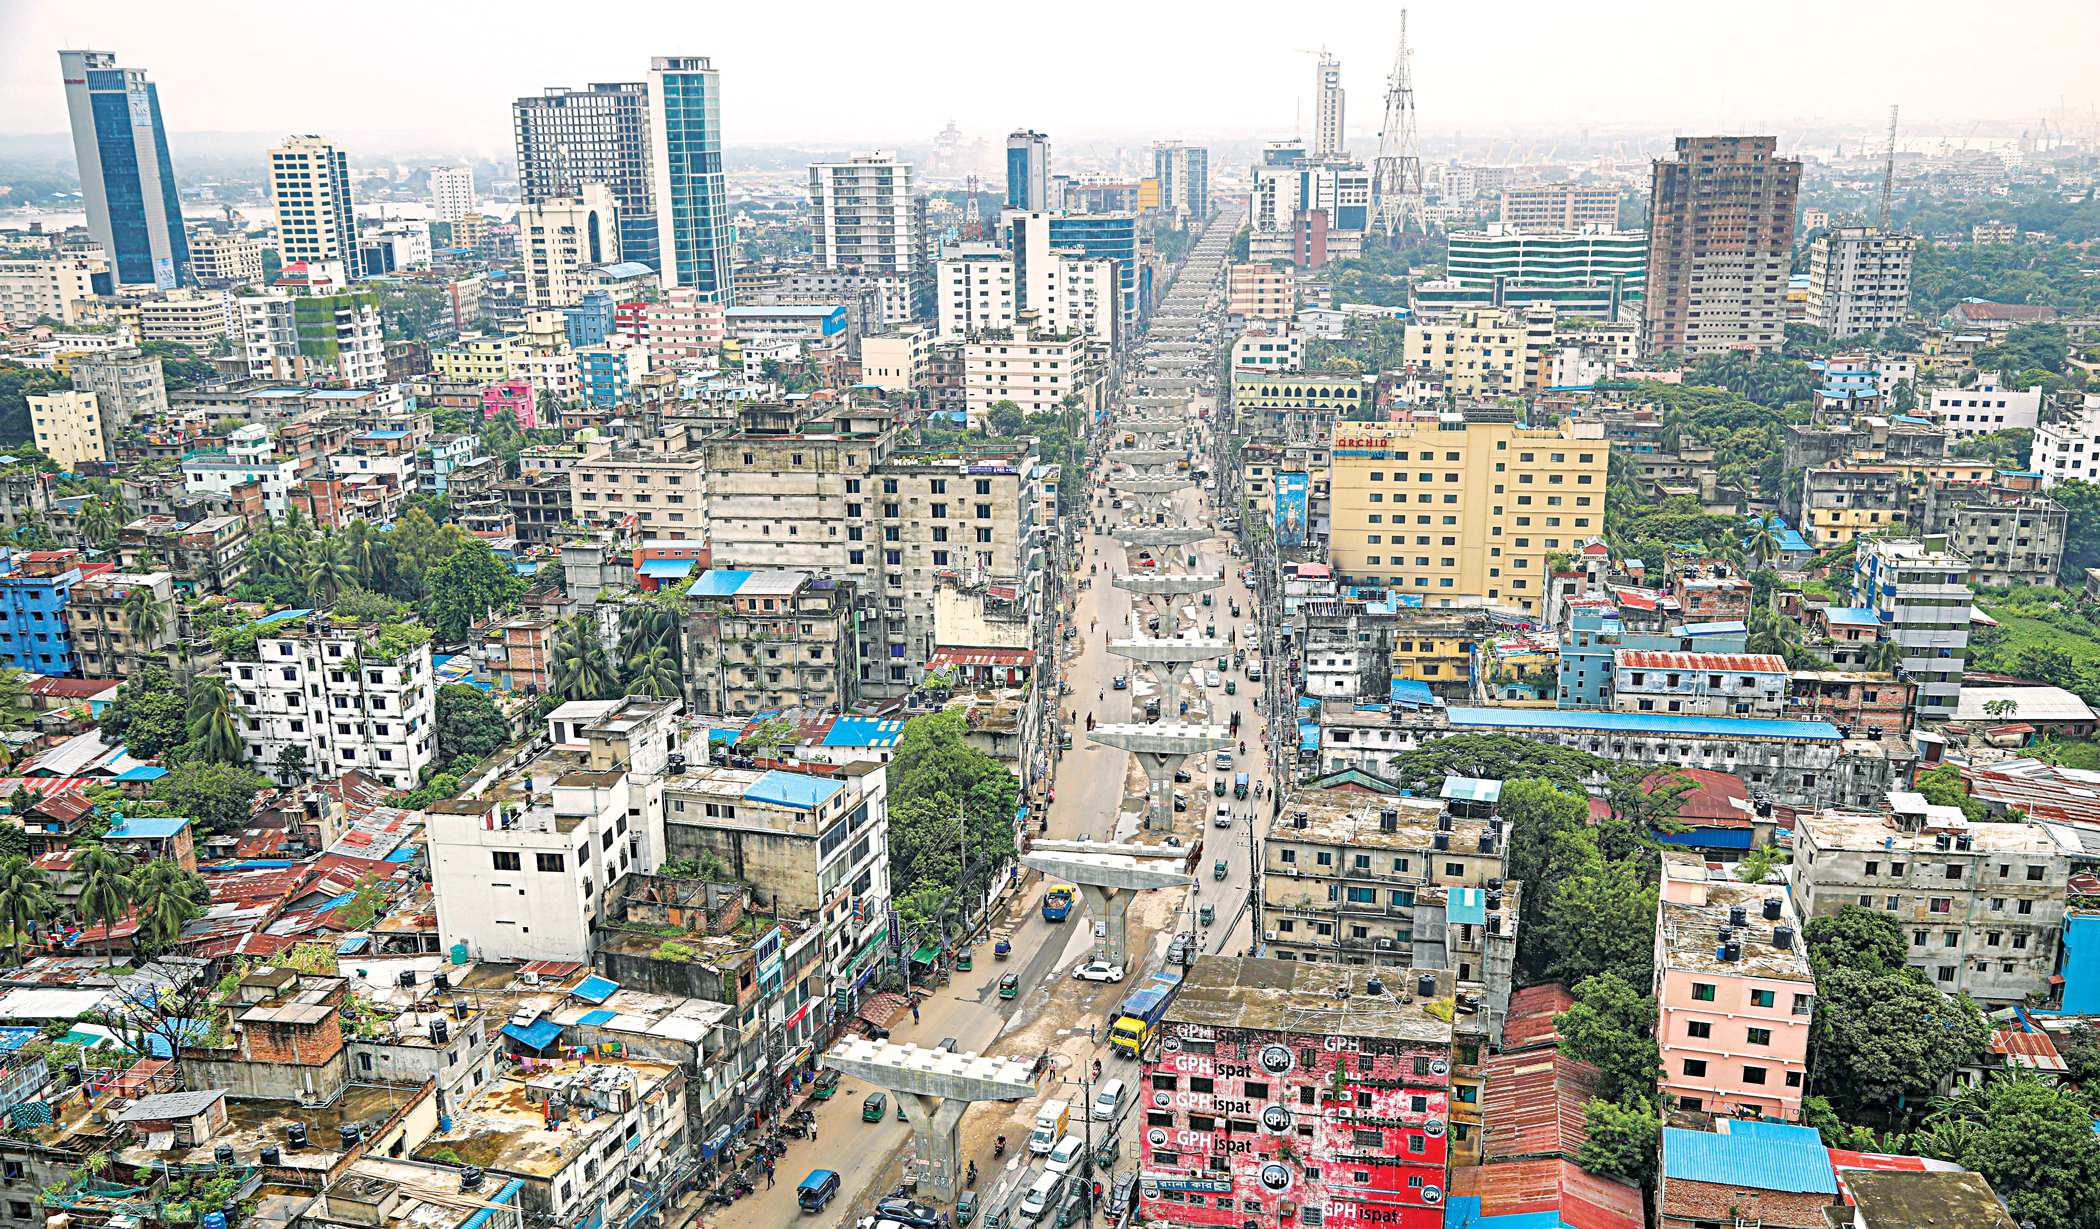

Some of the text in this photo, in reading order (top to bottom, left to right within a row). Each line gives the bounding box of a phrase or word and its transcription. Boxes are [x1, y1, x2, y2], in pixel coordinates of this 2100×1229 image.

[1338, 438, 1388, 447] ORCHID
[1371, 450, 1396, 458] HOTEL
[1176, 1023, 1212, 1039] GPH
[1323, 1036, 1360, 1052] GPH
[1175, 1056, 1252, 1079] GPH ispat
[1265, 1055, 1289, 1067] GPH
[1433, 1064, 1446, 1072] GPH
[1176, 1092, 1252, 1115] GPH ispat
[1265, 1113, 1289, 1127] GPH
[1150, 1133, 1165, 1142] GPH
[1177, 1130, 1252, 1155] GPH ispat
[1264, 1172, 1288, 1185] GPH
[1146, 1189, 1158, 1197] GPH
[1424, 1191, 1439, 1199] GPH
[1321, 1201, 1399, 1224] GPH ispat
